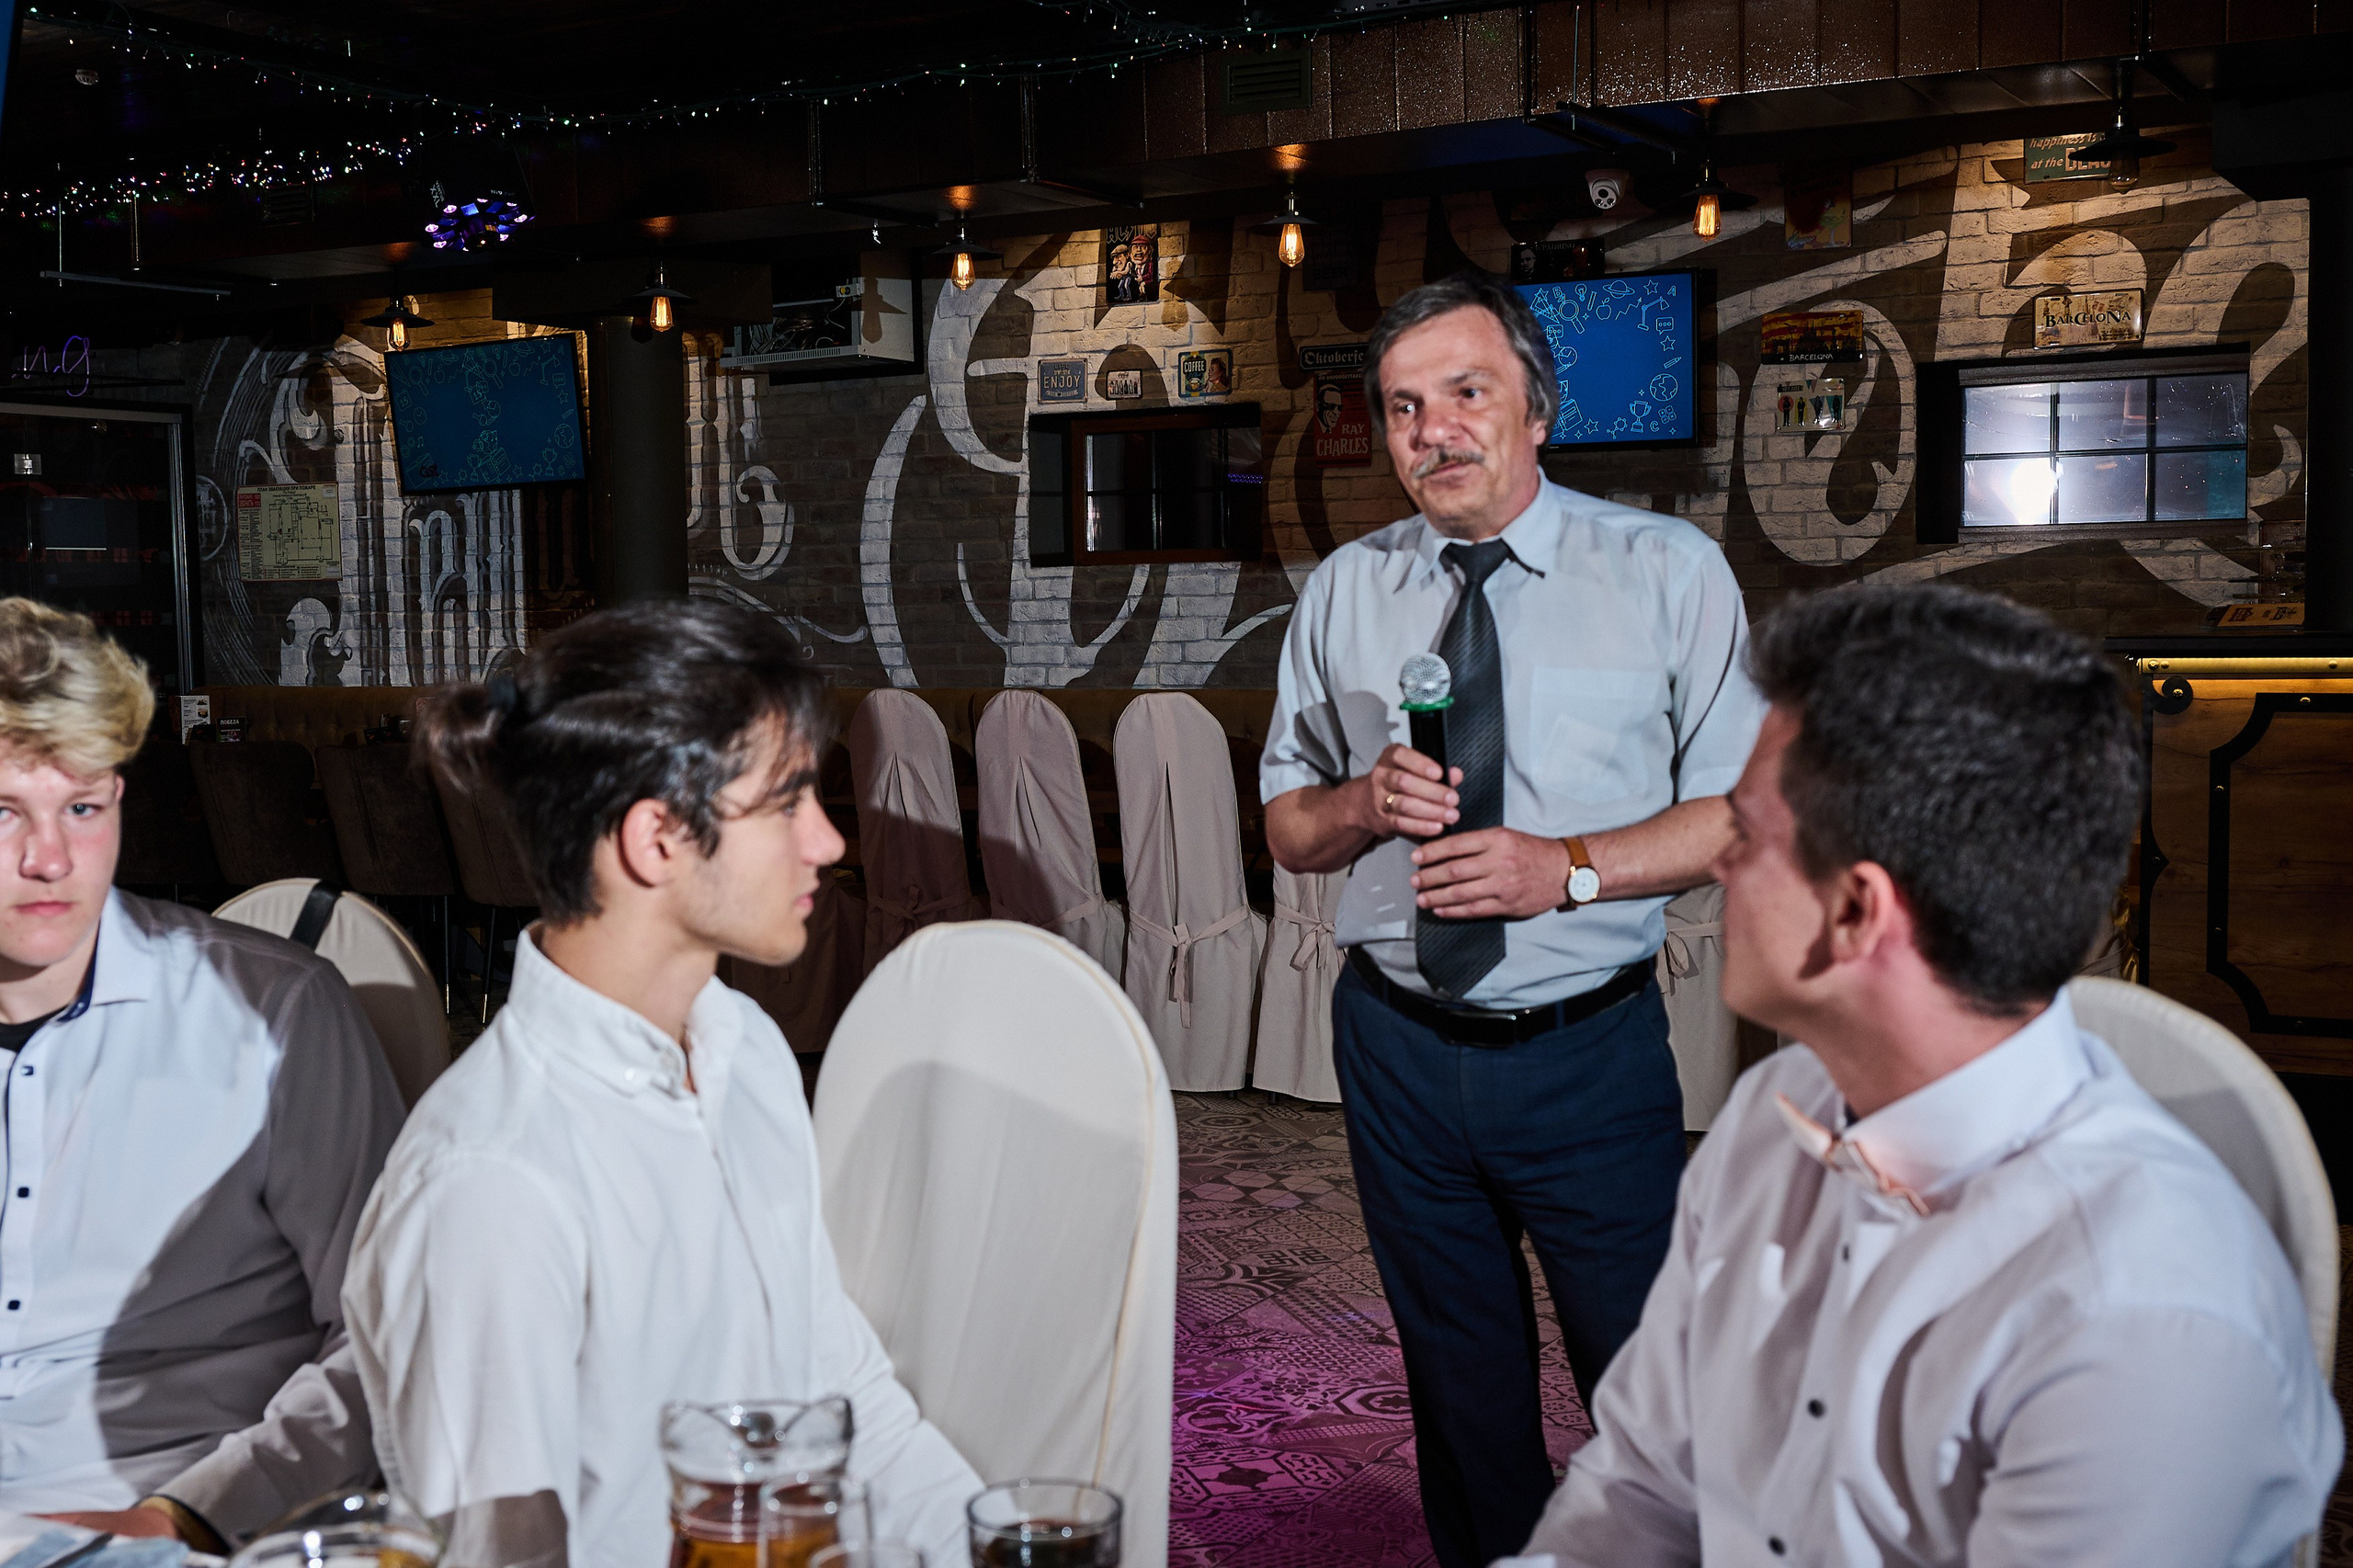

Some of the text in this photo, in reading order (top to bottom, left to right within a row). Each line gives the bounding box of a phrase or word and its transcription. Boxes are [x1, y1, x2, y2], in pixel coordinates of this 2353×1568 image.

[2029, 135, 2086, 150] happiness
[2030, 159, 2043, 170] at
[2044, 157, 2064, 168] the
[1305, 350, 1365, 366] Oktoberfe
[1789, 353, 1834, 361] BARCELONA
[1184, 360, 1205, 373] COFFEE
[1043, 375, 1081, 389] ENJOY
[1342, 424, 1366, 435] RAY
[1316, 437, 1369, 457] CHARLES
